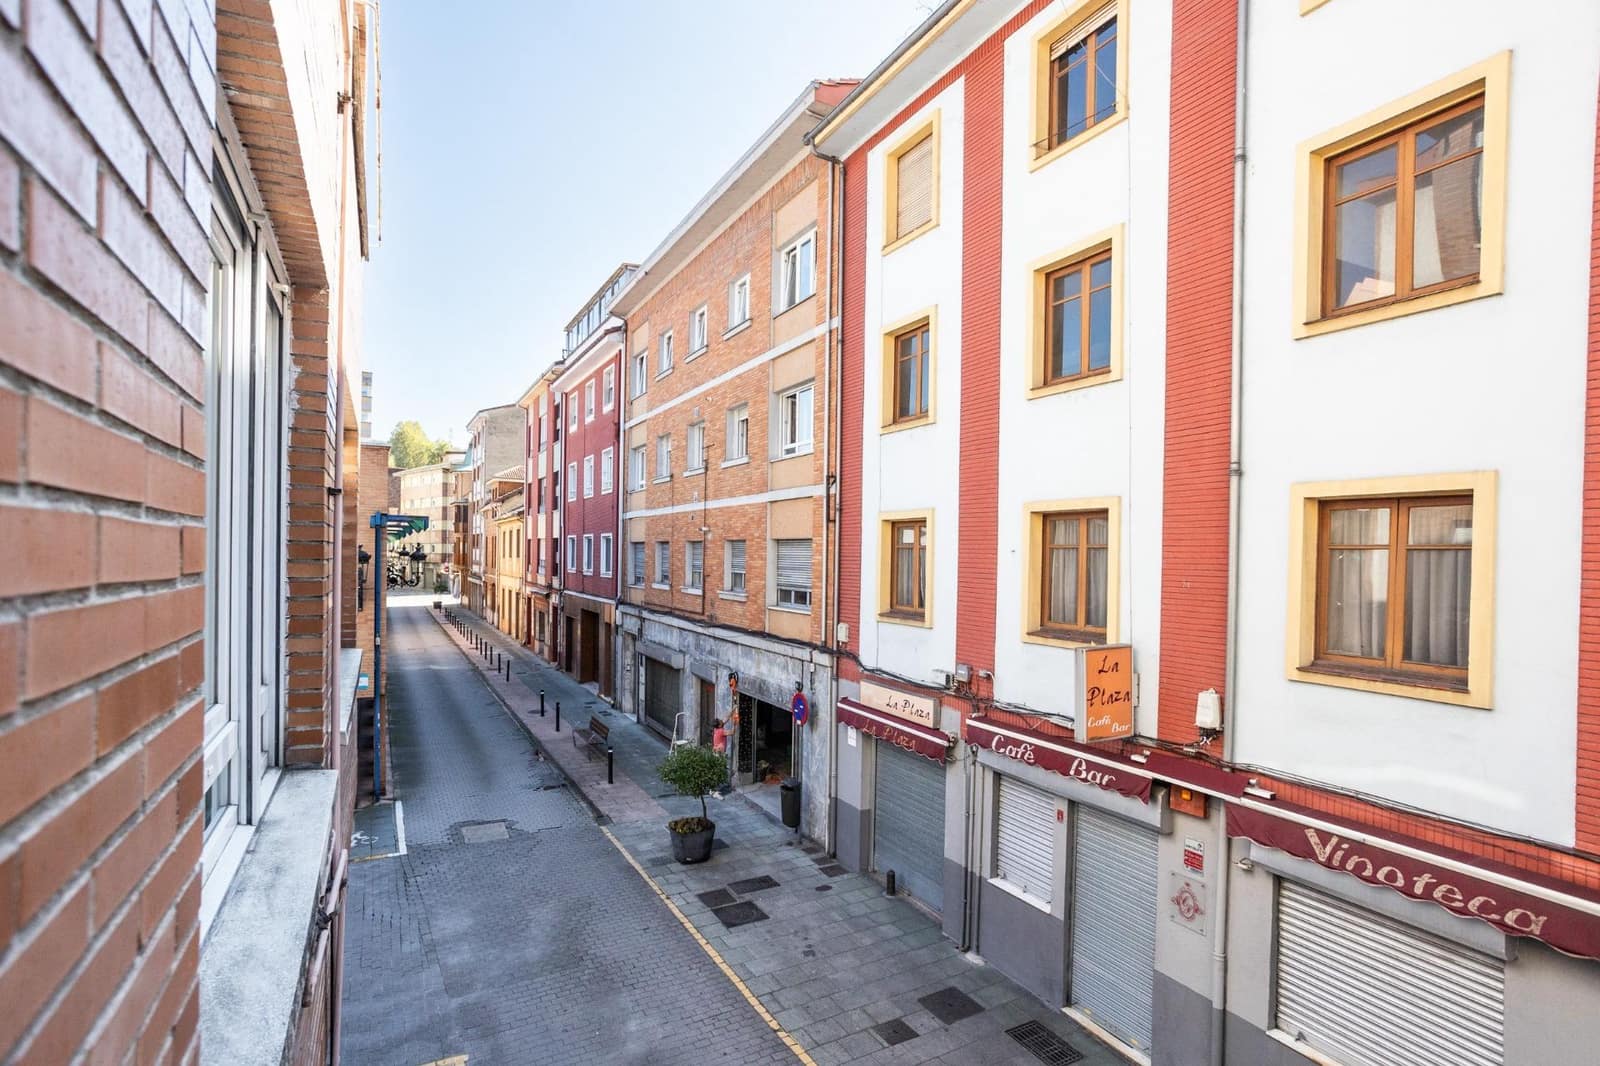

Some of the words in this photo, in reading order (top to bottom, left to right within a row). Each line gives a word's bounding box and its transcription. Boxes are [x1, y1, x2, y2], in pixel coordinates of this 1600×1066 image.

[1098, 655, 1119, 674] La
[886, 695, 898, 710] La
[901, 699, 931, 721] Plaza
[1087, 686, 1131, 708] Plaza
[1111, 722, 1132, 734] Bar
[991, 734, 1035, 763] Café
[1069, 758, 1116, 786] Bar
[1304, 828, 1547, 935] Vinoteca
